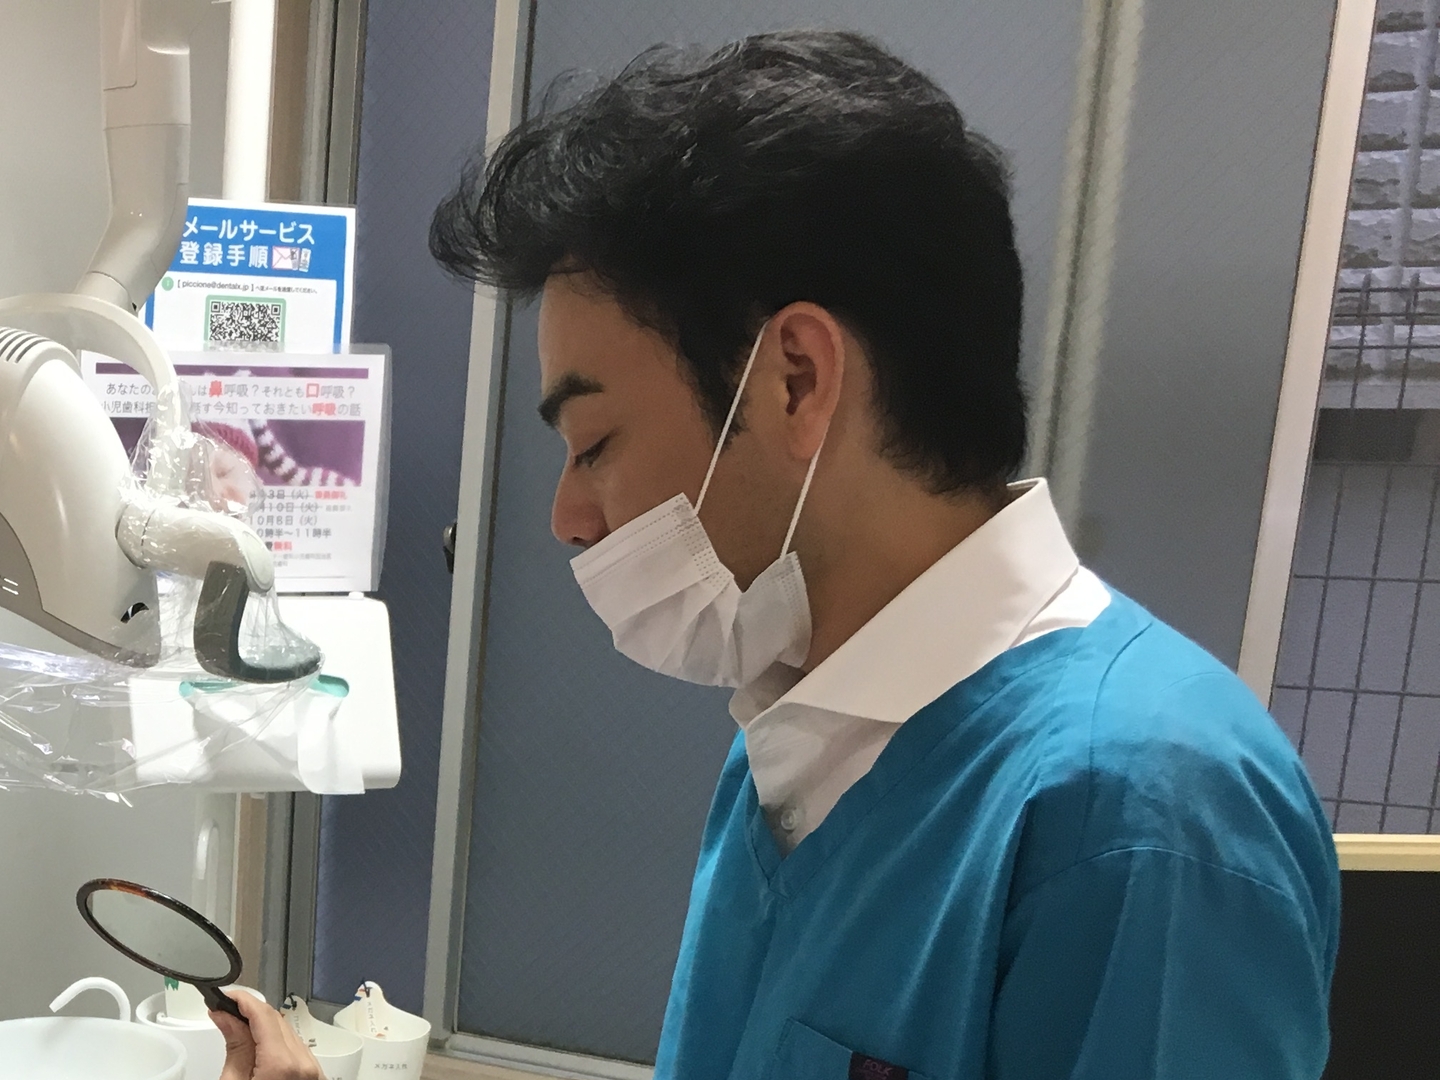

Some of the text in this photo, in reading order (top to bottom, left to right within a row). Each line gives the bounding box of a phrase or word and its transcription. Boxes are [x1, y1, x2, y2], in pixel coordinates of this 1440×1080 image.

[182, 215, 315, 245] メールサービス
[179, 240, 269, 269] 登録手順
[862, 1058, 893, 1077] FOLK
